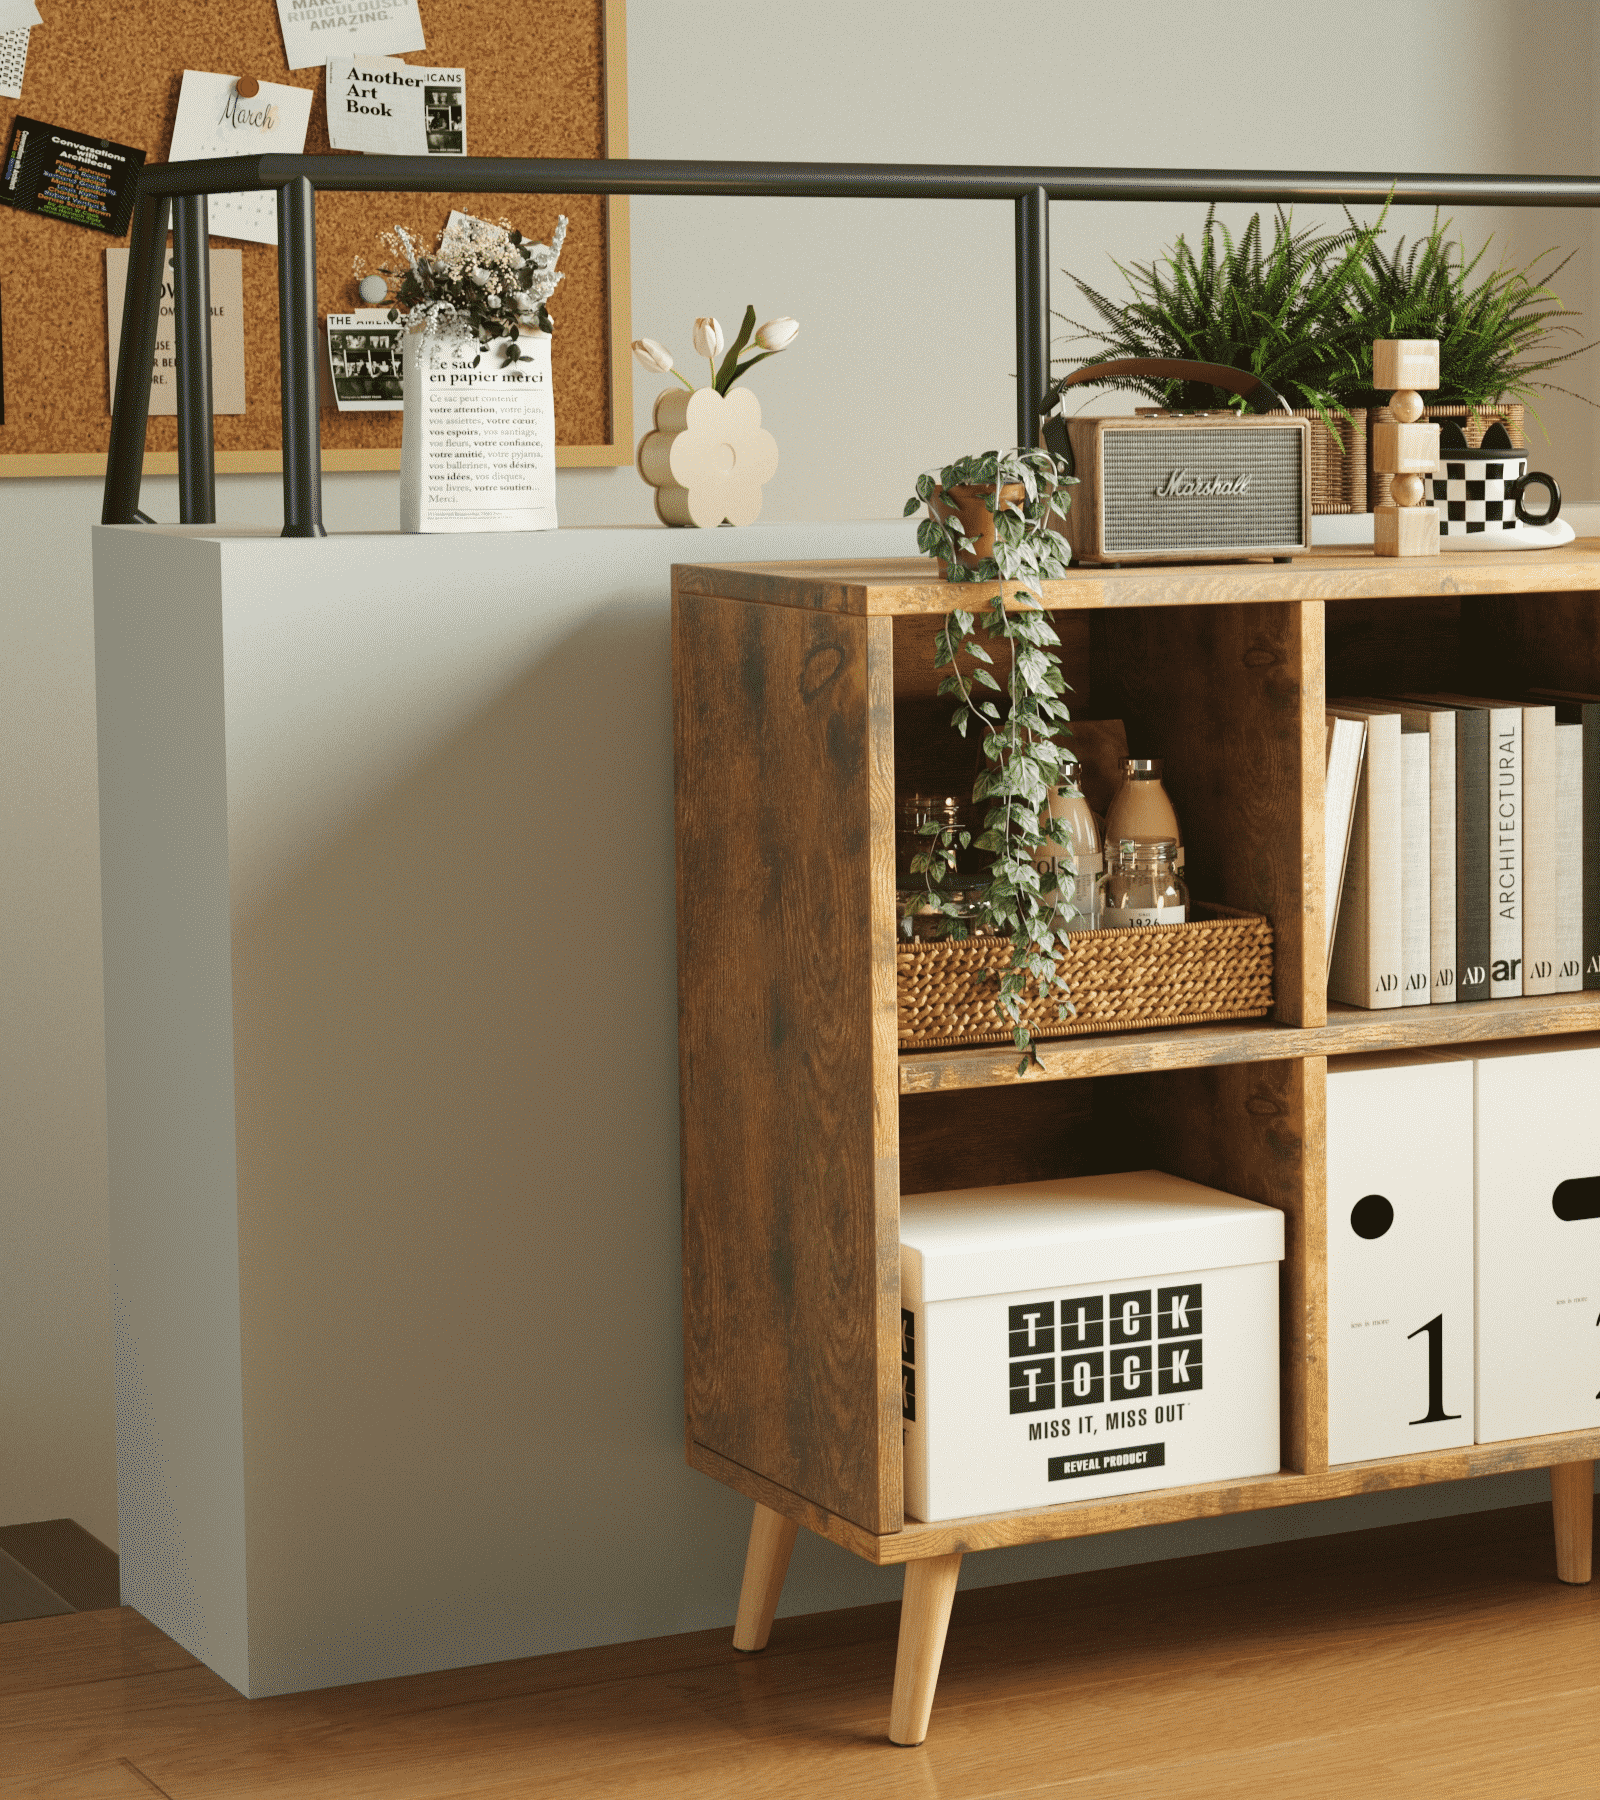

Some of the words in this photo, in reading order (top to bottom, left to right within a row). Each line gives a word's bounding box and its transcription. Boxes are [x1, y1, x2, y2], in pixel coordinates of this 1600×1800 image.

[310, 10, 394, 31] AMAZING.
[346, 67, 424, 88] Another
[424, 73, 462, 83] ICANS
[346, 83, 378, 100] Art
[218, 92, 275, 129] March
[346, 99, 393, 117] Book
[51, 136, 126, 162] Conversations
[77, 150, 99, 160] with
[59, 151, 112, 170] Architects
[329, 316, 351, 325] THE
[430, 374, 446, 382] en
[450, 371, 498, 386] papier
[502, 372, 544, 383] merci
[429, 394, 442, 403] Ce
[460, 395, 479, 405] peut
[481, 395, 518, 403] contenir
[453, 406, 498, 415] attention,
[446, 428, 481, 437] espoirs,
[499, 439, 544, 448] confiance,
[447, 472, 473, 481] idées,
[1157, 468, 1252, 496] Marshall
[1498, 726, 1515, 920] ARCHITECTURAL
[1435, 968, 1454, 987] AD
[1462, 966, 1486, 985] AD
[1492, 958, 1521, 982] ar
[1530, 961, 1552, 979] AD
[1559, 960, 1580, 978] AD
[1375, 974, 1398, 992] AD
[1405, 973, 1427, 991] AD
[1022, 1294, 1190, 1348] TICK
[1023, 1349, 1190, 1403] TOCK
[1407, 1312, 1462, 1426] 1
[1028, 1418, 1071, 1442] MISS
[1078, 1415, 1098, 1436] IT,
[1105, 1408, 1147, 1431] MISS
[1155, 1403, 1186, 1424] OUT
[1063, 1458, 1101, 1474] REVEAL
[1103, 1451, 1148, 1469] PRODUCT
